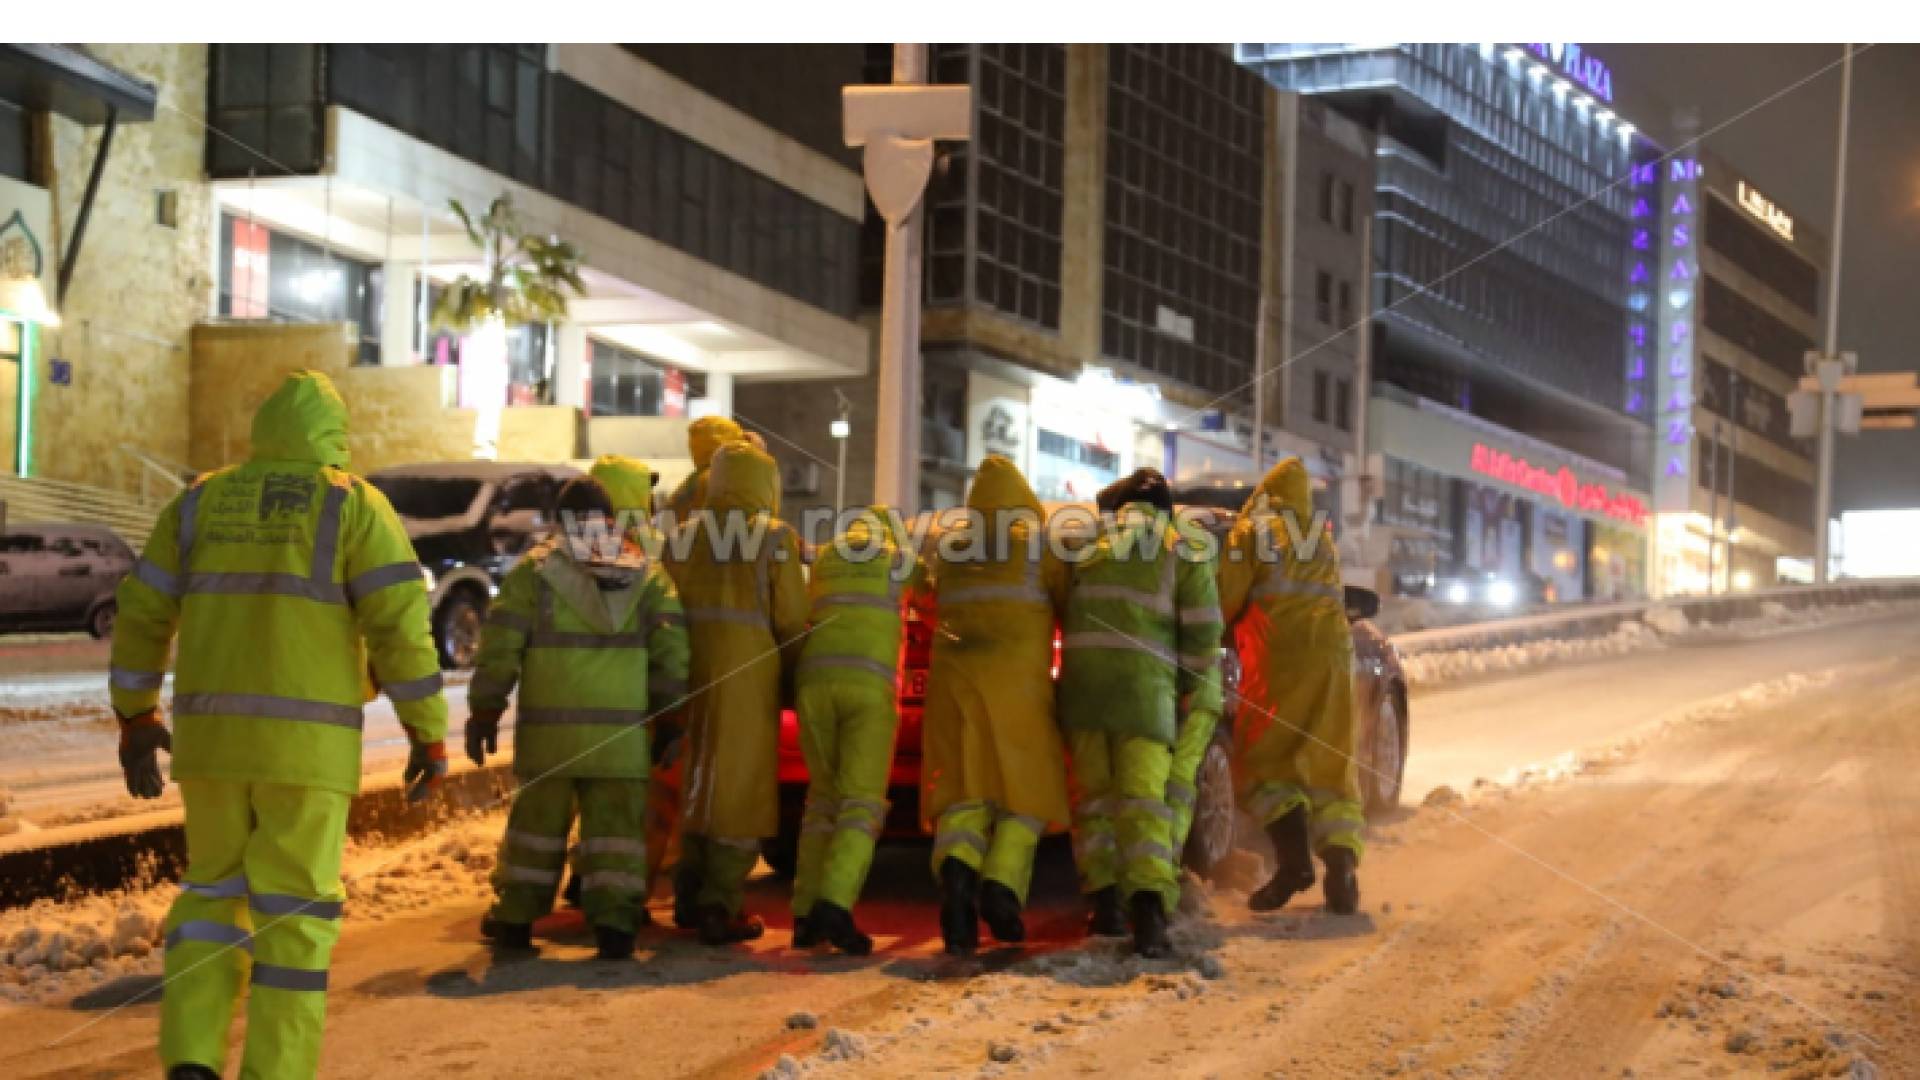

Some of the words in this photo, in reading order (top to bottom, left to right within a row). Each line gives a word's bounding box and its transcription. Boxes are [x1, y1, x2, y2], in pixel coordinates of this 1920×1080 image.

[1563, 43, 1613, 104] PLAZA
[1670, 158, 1697, 281] MASA
[1665, 321, 1690, 478] PLAZA
